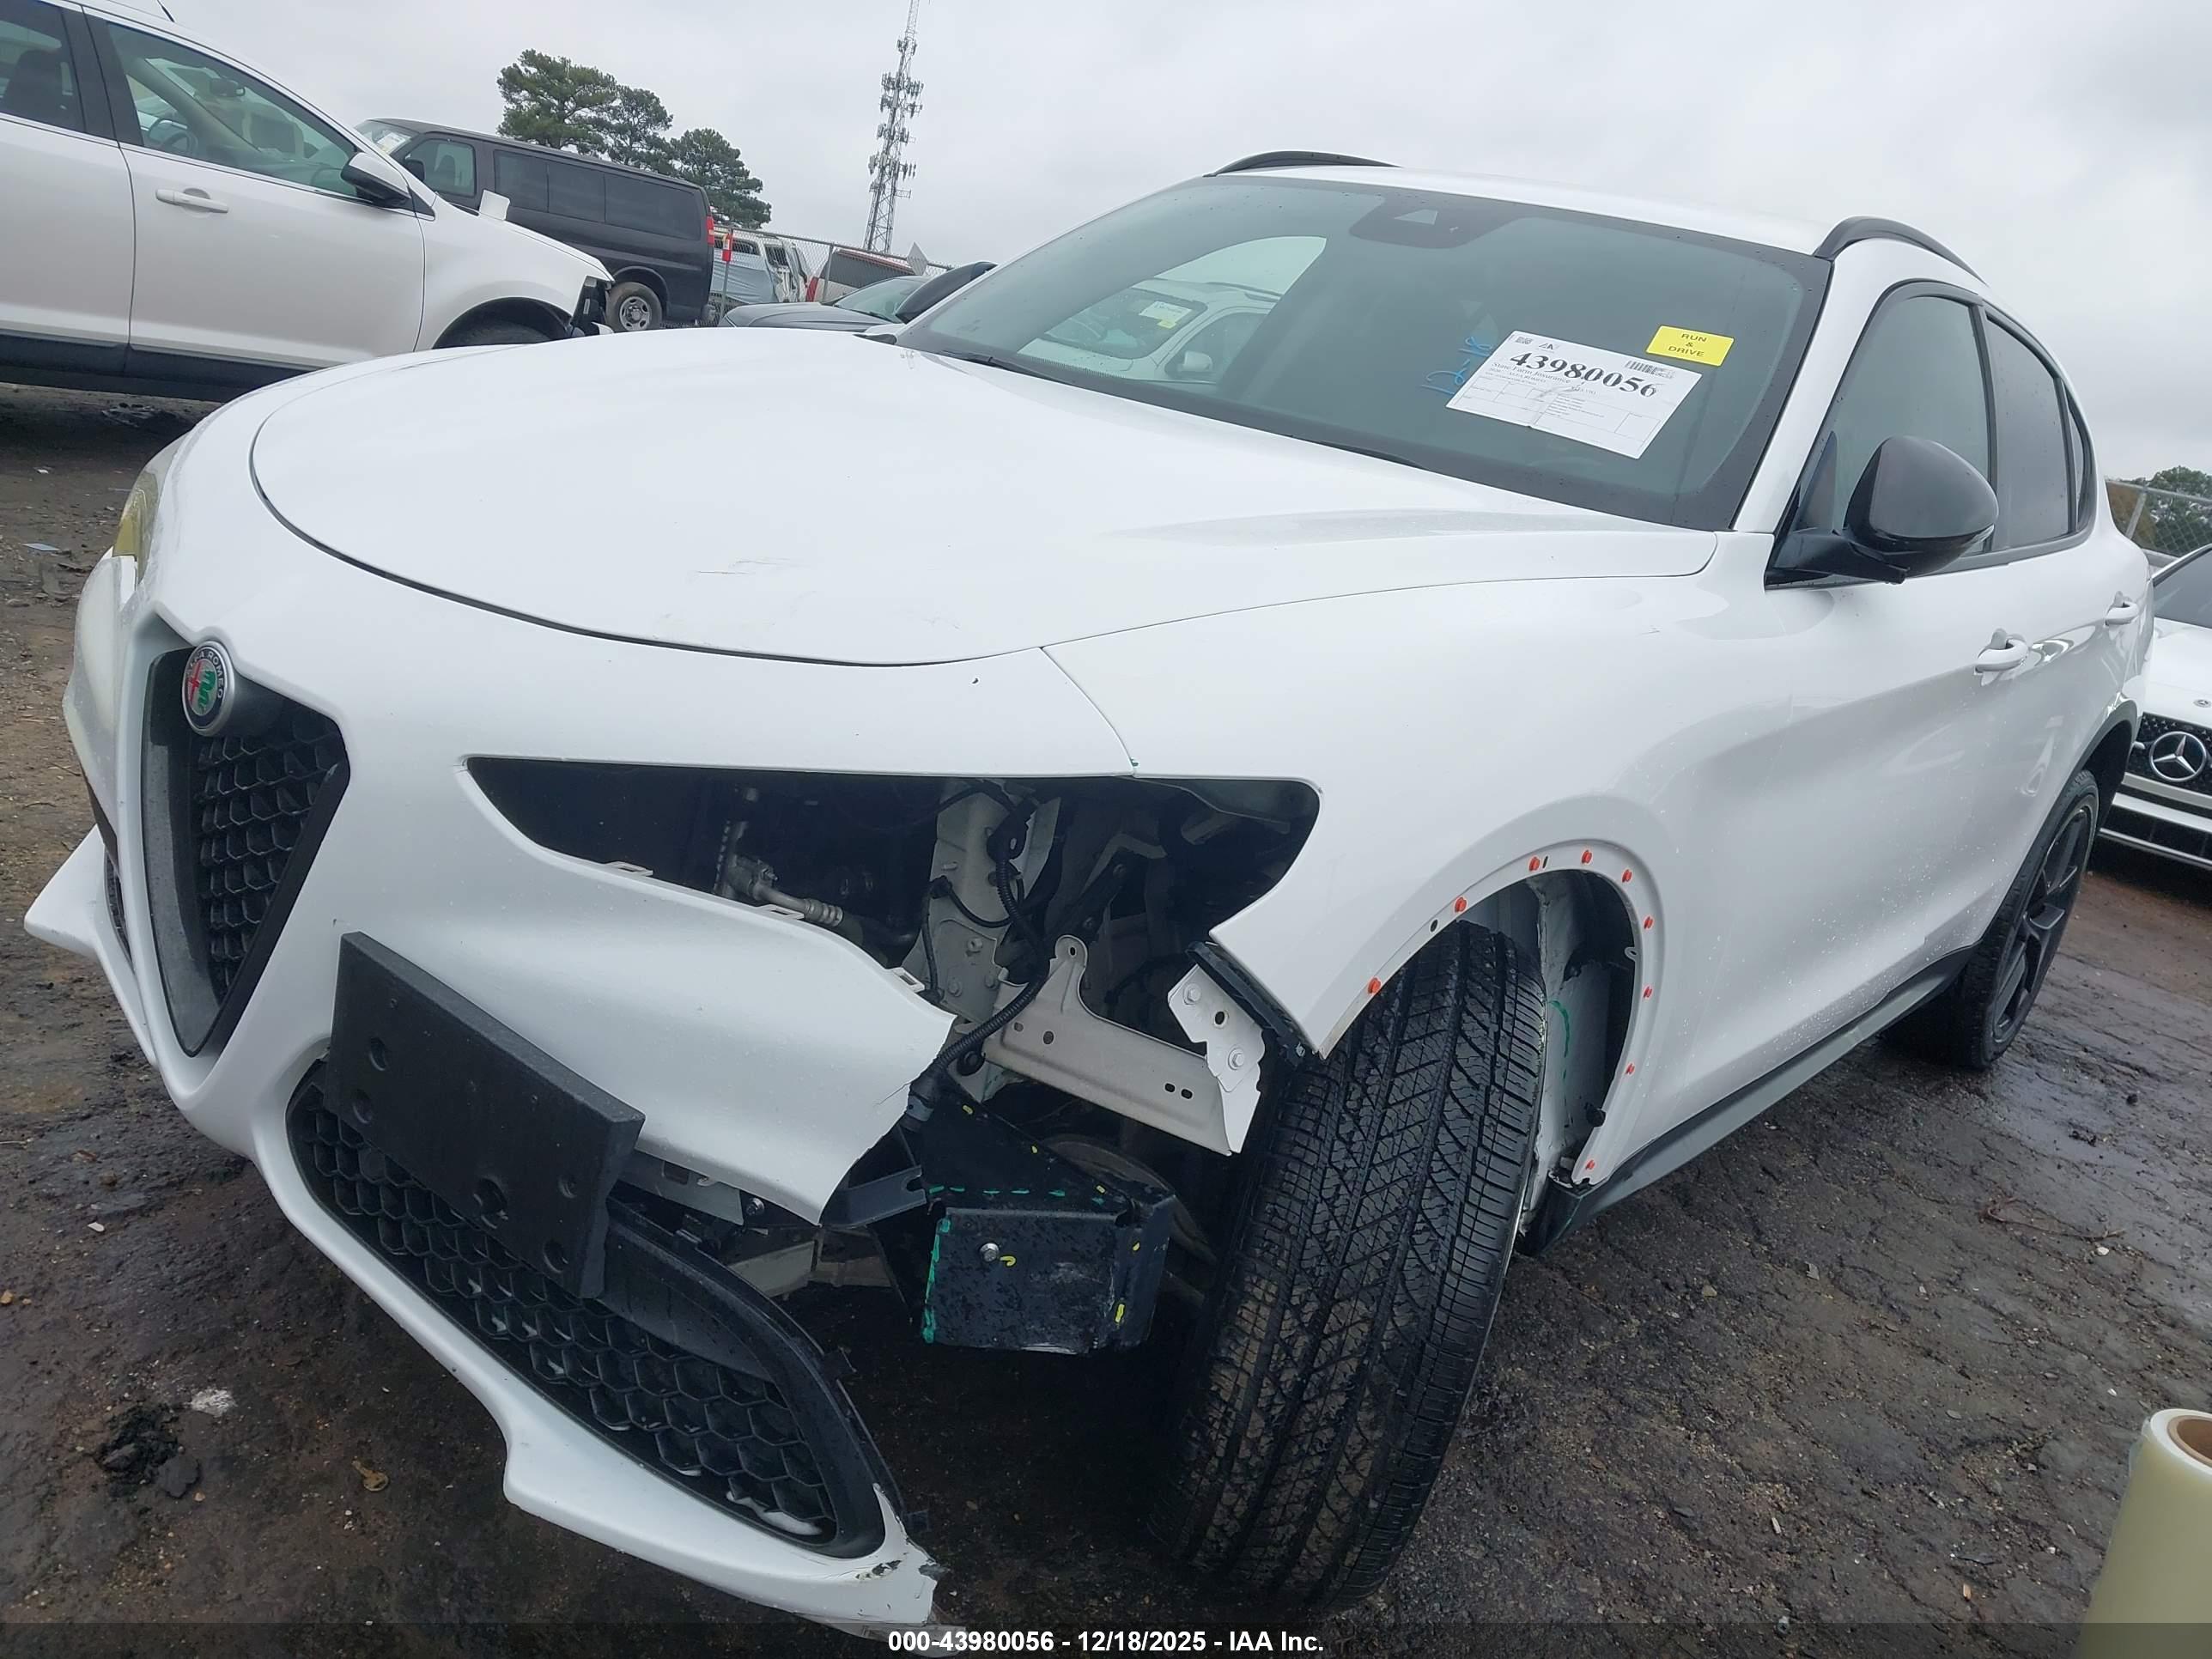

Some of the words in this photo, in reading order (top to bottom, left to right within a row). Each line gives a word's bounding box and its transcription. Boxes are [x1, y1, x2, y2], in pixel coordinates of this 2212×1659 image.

[1680, 333, 1707, 343] RUN
[1668, 345, 1705, 357] DRIVE
[1510, 352, 1663, 398] 43980056
[1512, 365, 1533, 375] Farm
[1534, 371, 1571, 384] Insurance
[207, 651, 224, 699] ROMEO
